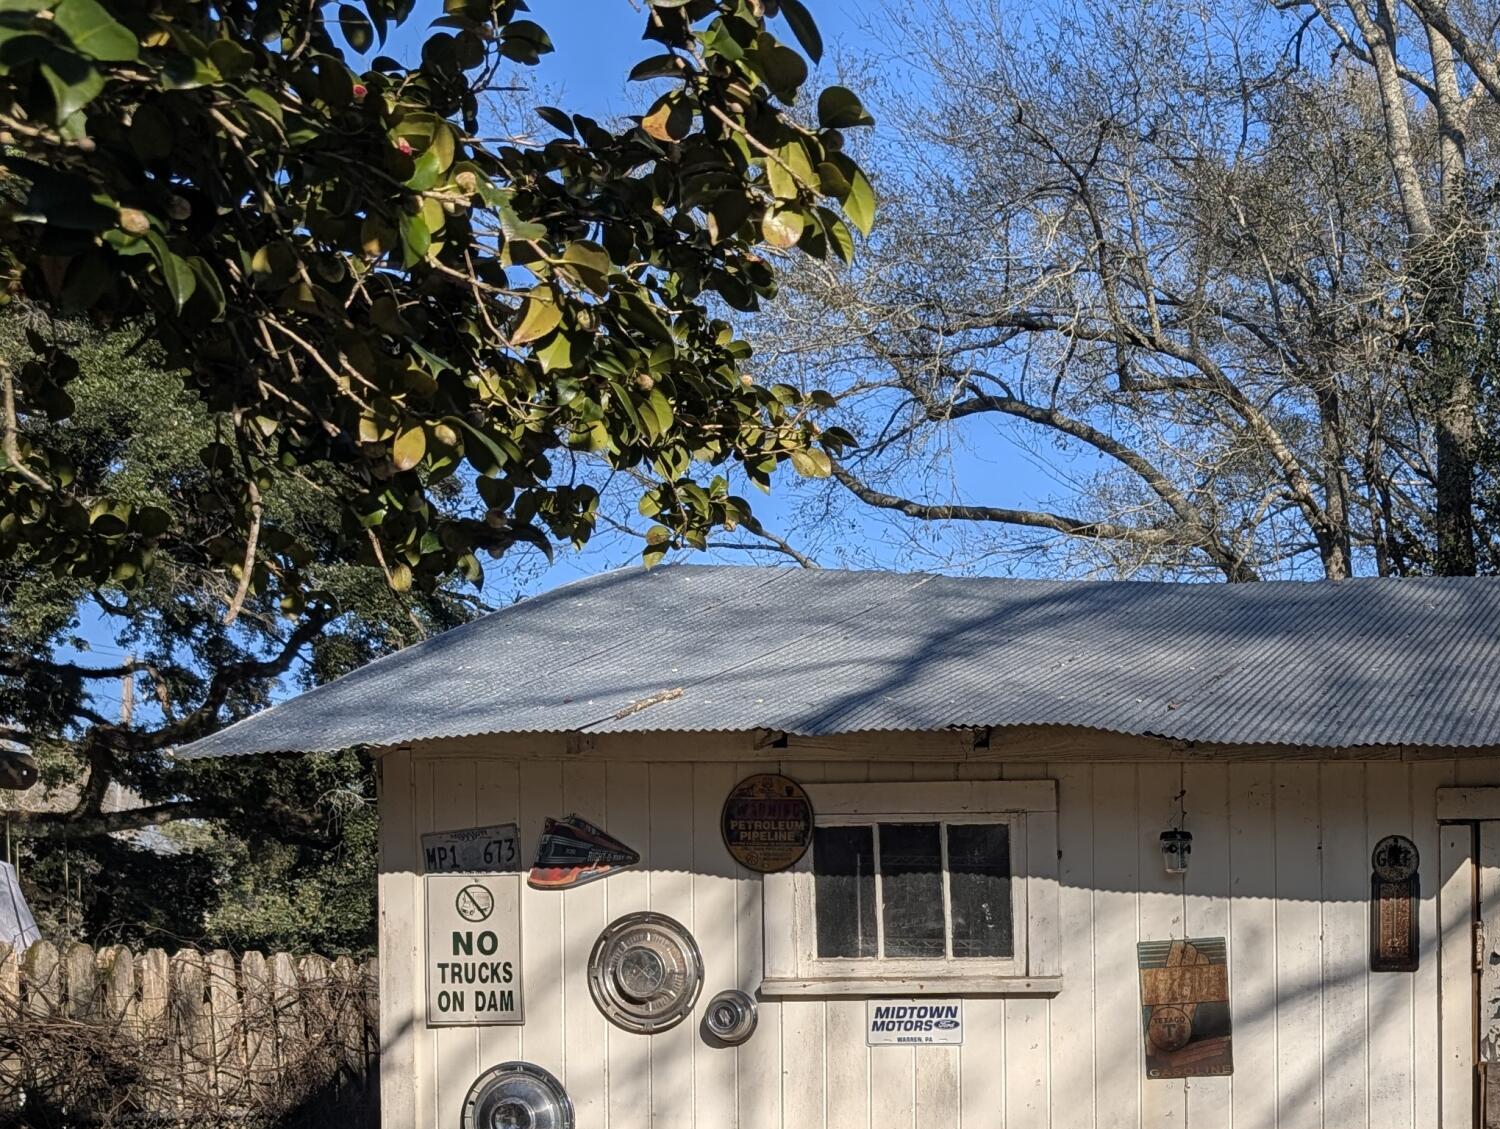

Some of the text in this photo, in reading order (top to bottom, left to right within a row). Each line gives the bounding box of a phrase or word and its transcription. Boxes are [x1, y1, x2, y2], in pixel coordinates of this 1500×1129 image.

[730, 820, 805, 831] PETROLEUM
[740, 831, 795, 841] PIPELINE
[426, 838, 515, 871] MP1 673
[452, 931, 499, 956] NO
[437, 961, 513, 984] TRUCKS
[437, 990, 514, 1012] ON DAM
[874, 1006, 958, 1019] MIDTOWN
[871, 1020, 933, 1031] MOTORS
[1149, 1064, 1233, 1077] GASOLINE
